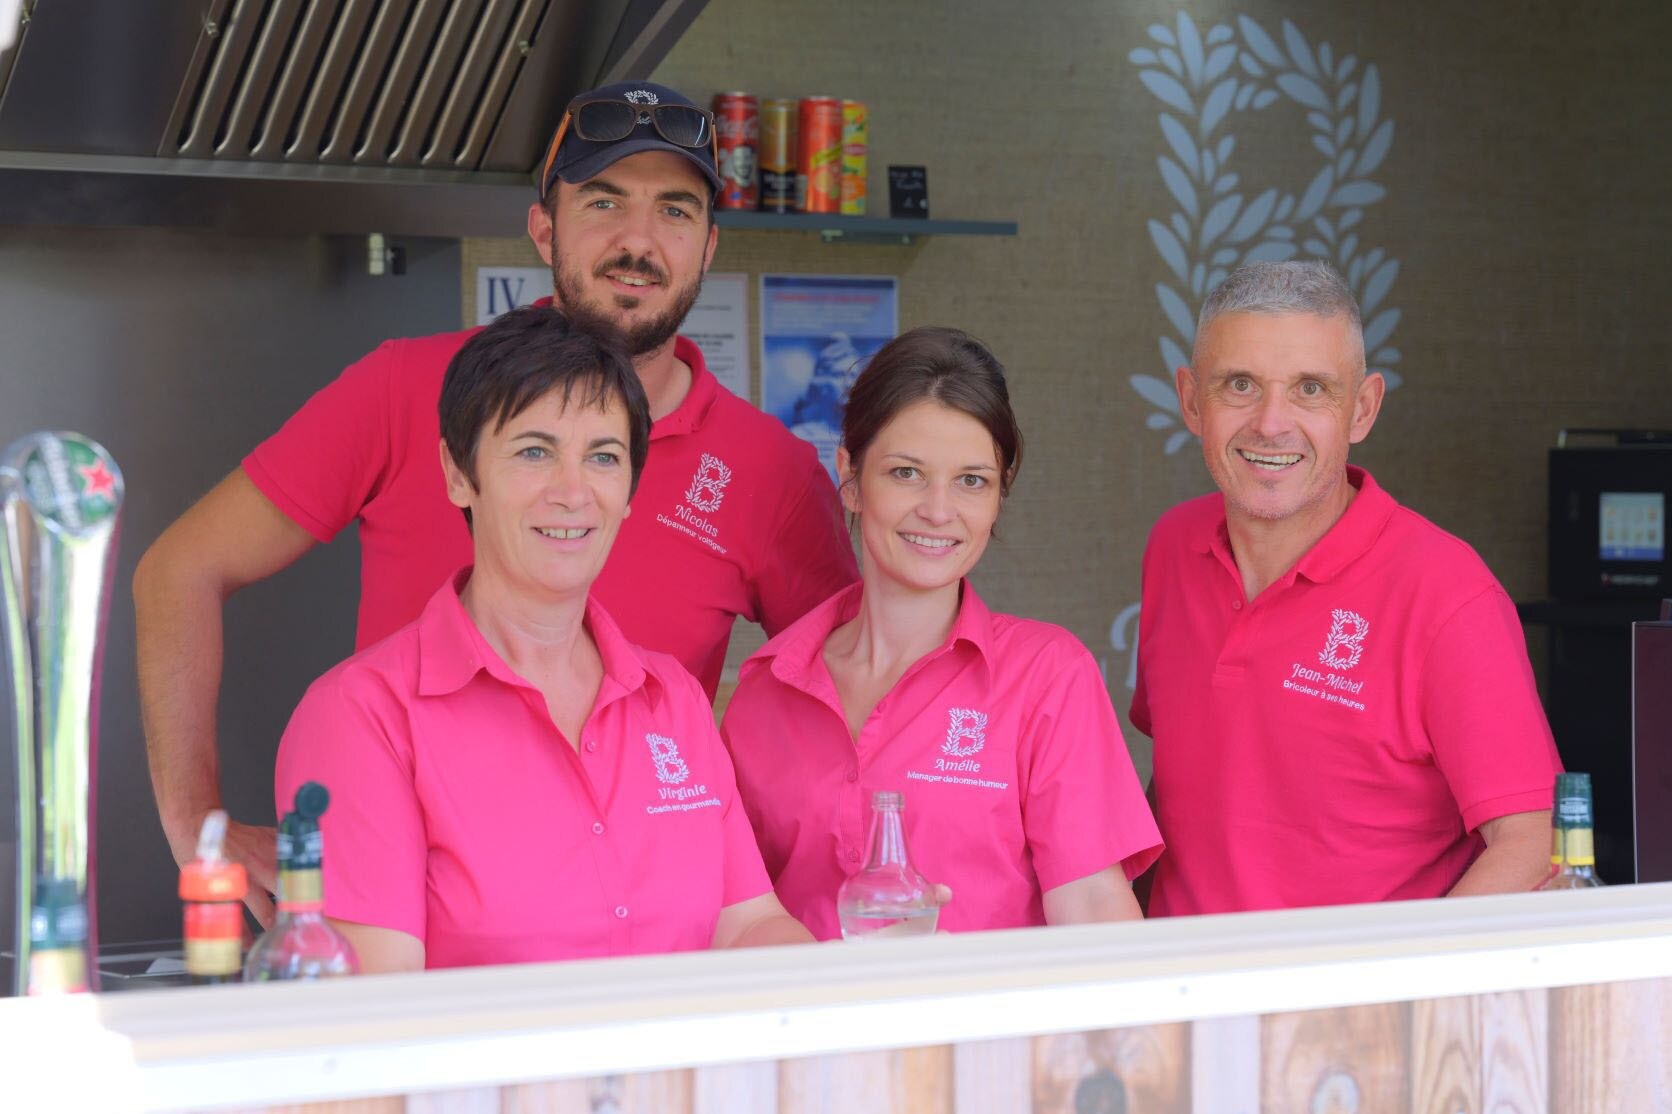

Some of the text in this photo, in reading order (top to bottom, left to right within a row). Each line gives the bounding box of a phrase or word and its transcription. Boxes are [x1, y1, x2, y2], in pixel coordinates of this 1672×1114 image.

[656, 513, 697, 537] Dépanneur
[675, 504, 718, 537] Nicolas
[1291, 663, 1363, 695] Jean-Michel
[1283, 679, 1319, 697] Bricoleur
[1338, 696, 1365, 711] heures
[934, 758, 981, 773] Amélie
[906, 770, 943, 783] Manager
[953, 775, 979, 786] bonne
[978, 778, 1009, 790] humeur
[658, 784, 706, 801] Virginie
